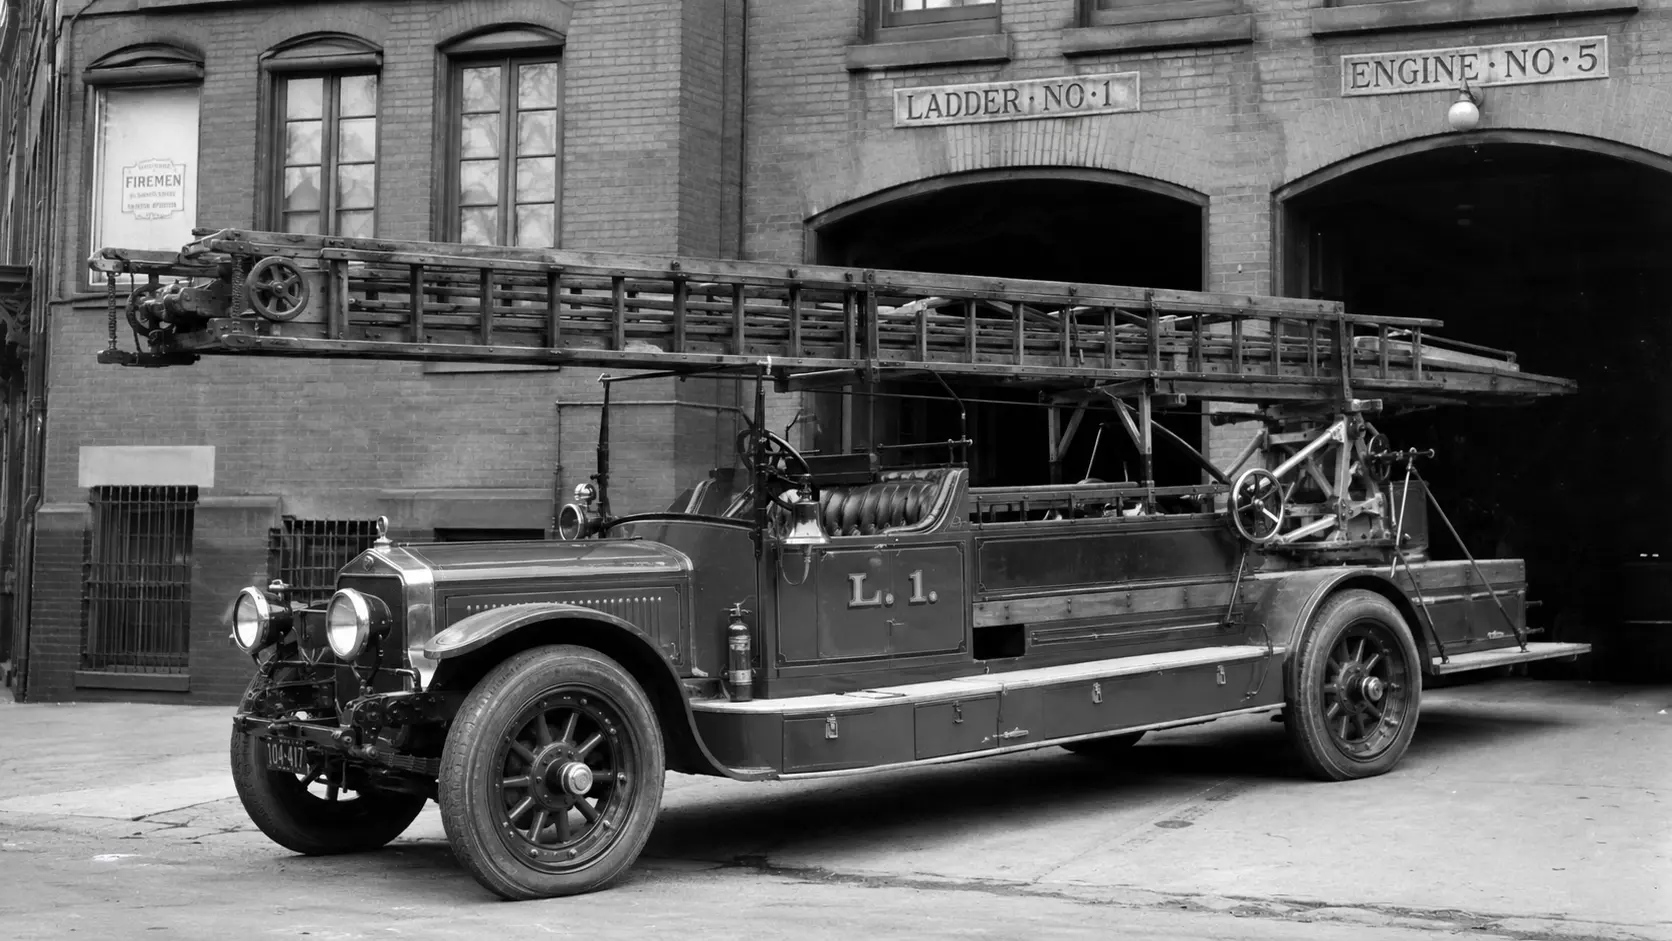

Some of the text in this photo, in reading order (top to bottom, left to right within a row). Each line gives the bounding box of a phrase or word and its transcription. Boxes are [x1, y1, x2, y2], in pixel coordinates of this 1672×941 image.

[1350, 53, 1479, 88] ENGINE
[1577, 44, 1598, 72] 5
[906, 88, 1021, 120] LADDER
[1102, 80, 1112, 107] 1
[126, 174, 181, 188] FIREMEN
[847, 569, 938, 608] L. 1.
